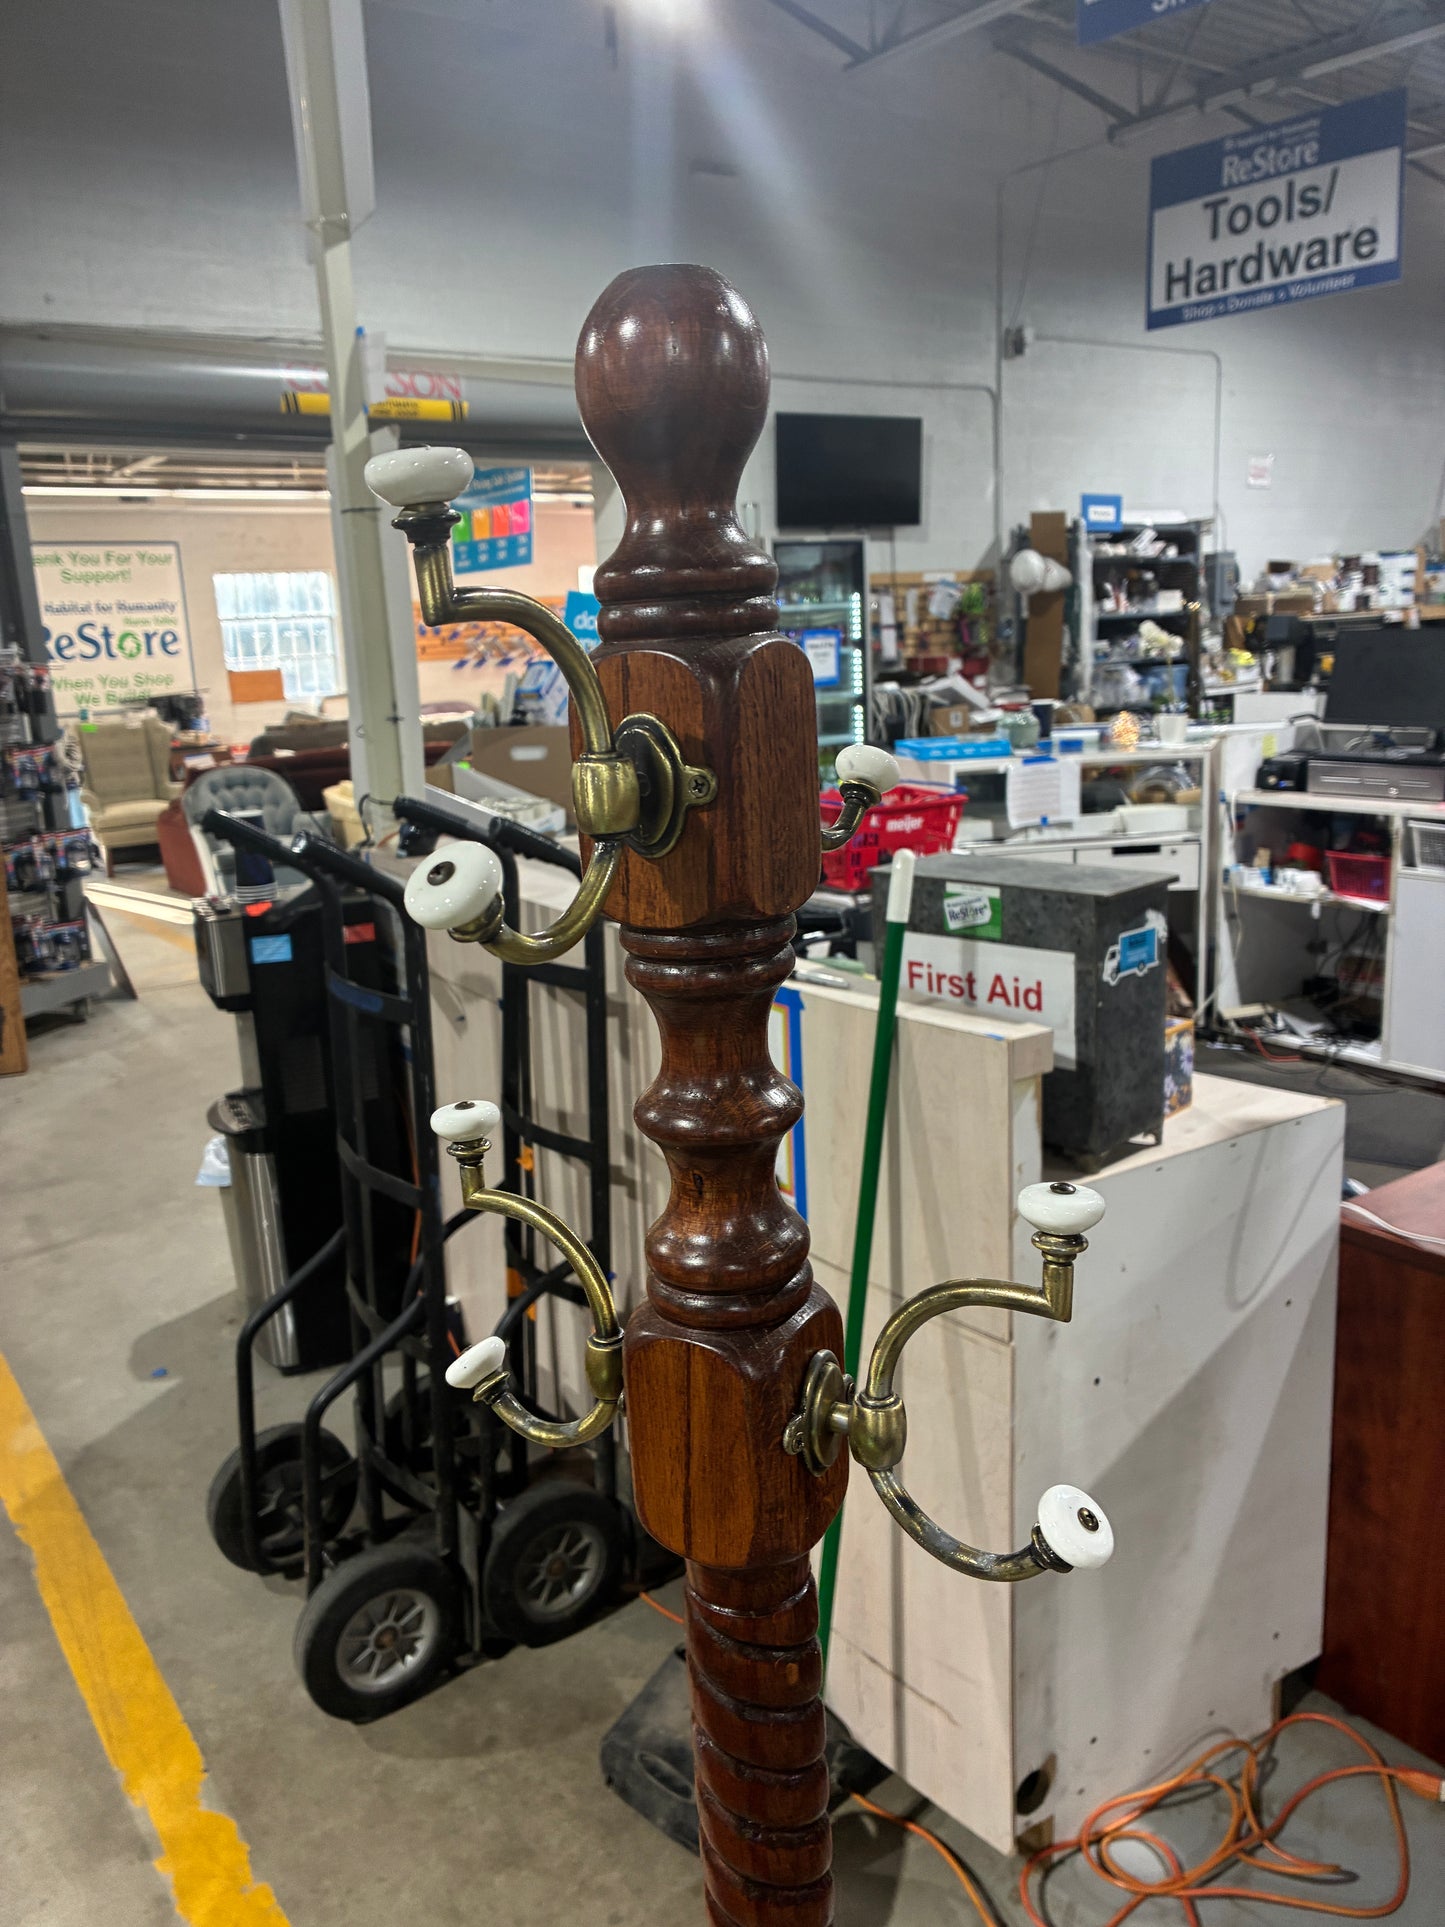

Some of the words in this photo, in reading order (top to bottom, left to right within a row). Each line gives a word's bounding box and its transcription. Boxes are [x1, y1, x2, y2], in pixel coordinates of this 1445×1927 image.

[1222, 141, 1319, 188] ReStore
[1203, 166, 1339, 241] Tools/
[1164, 226, 1379, 303] Hardware
[1182, 303, 1216, 321] Shop
[1227, 291, 1275, 312] Donate
[1288, 274, 1356, 298] Volunteer
[67, 551, 99, 566] You
[104, 551, 131, 566] For
[136, 551, 173, 566] Your
[97, 673, 129, 689] You
[133, 672, 174, 688] Shop
[885, 815, 924, 833] meijer
[907, 960, 977, 1001] First
[987, 974, 1043, 1013] Aid
